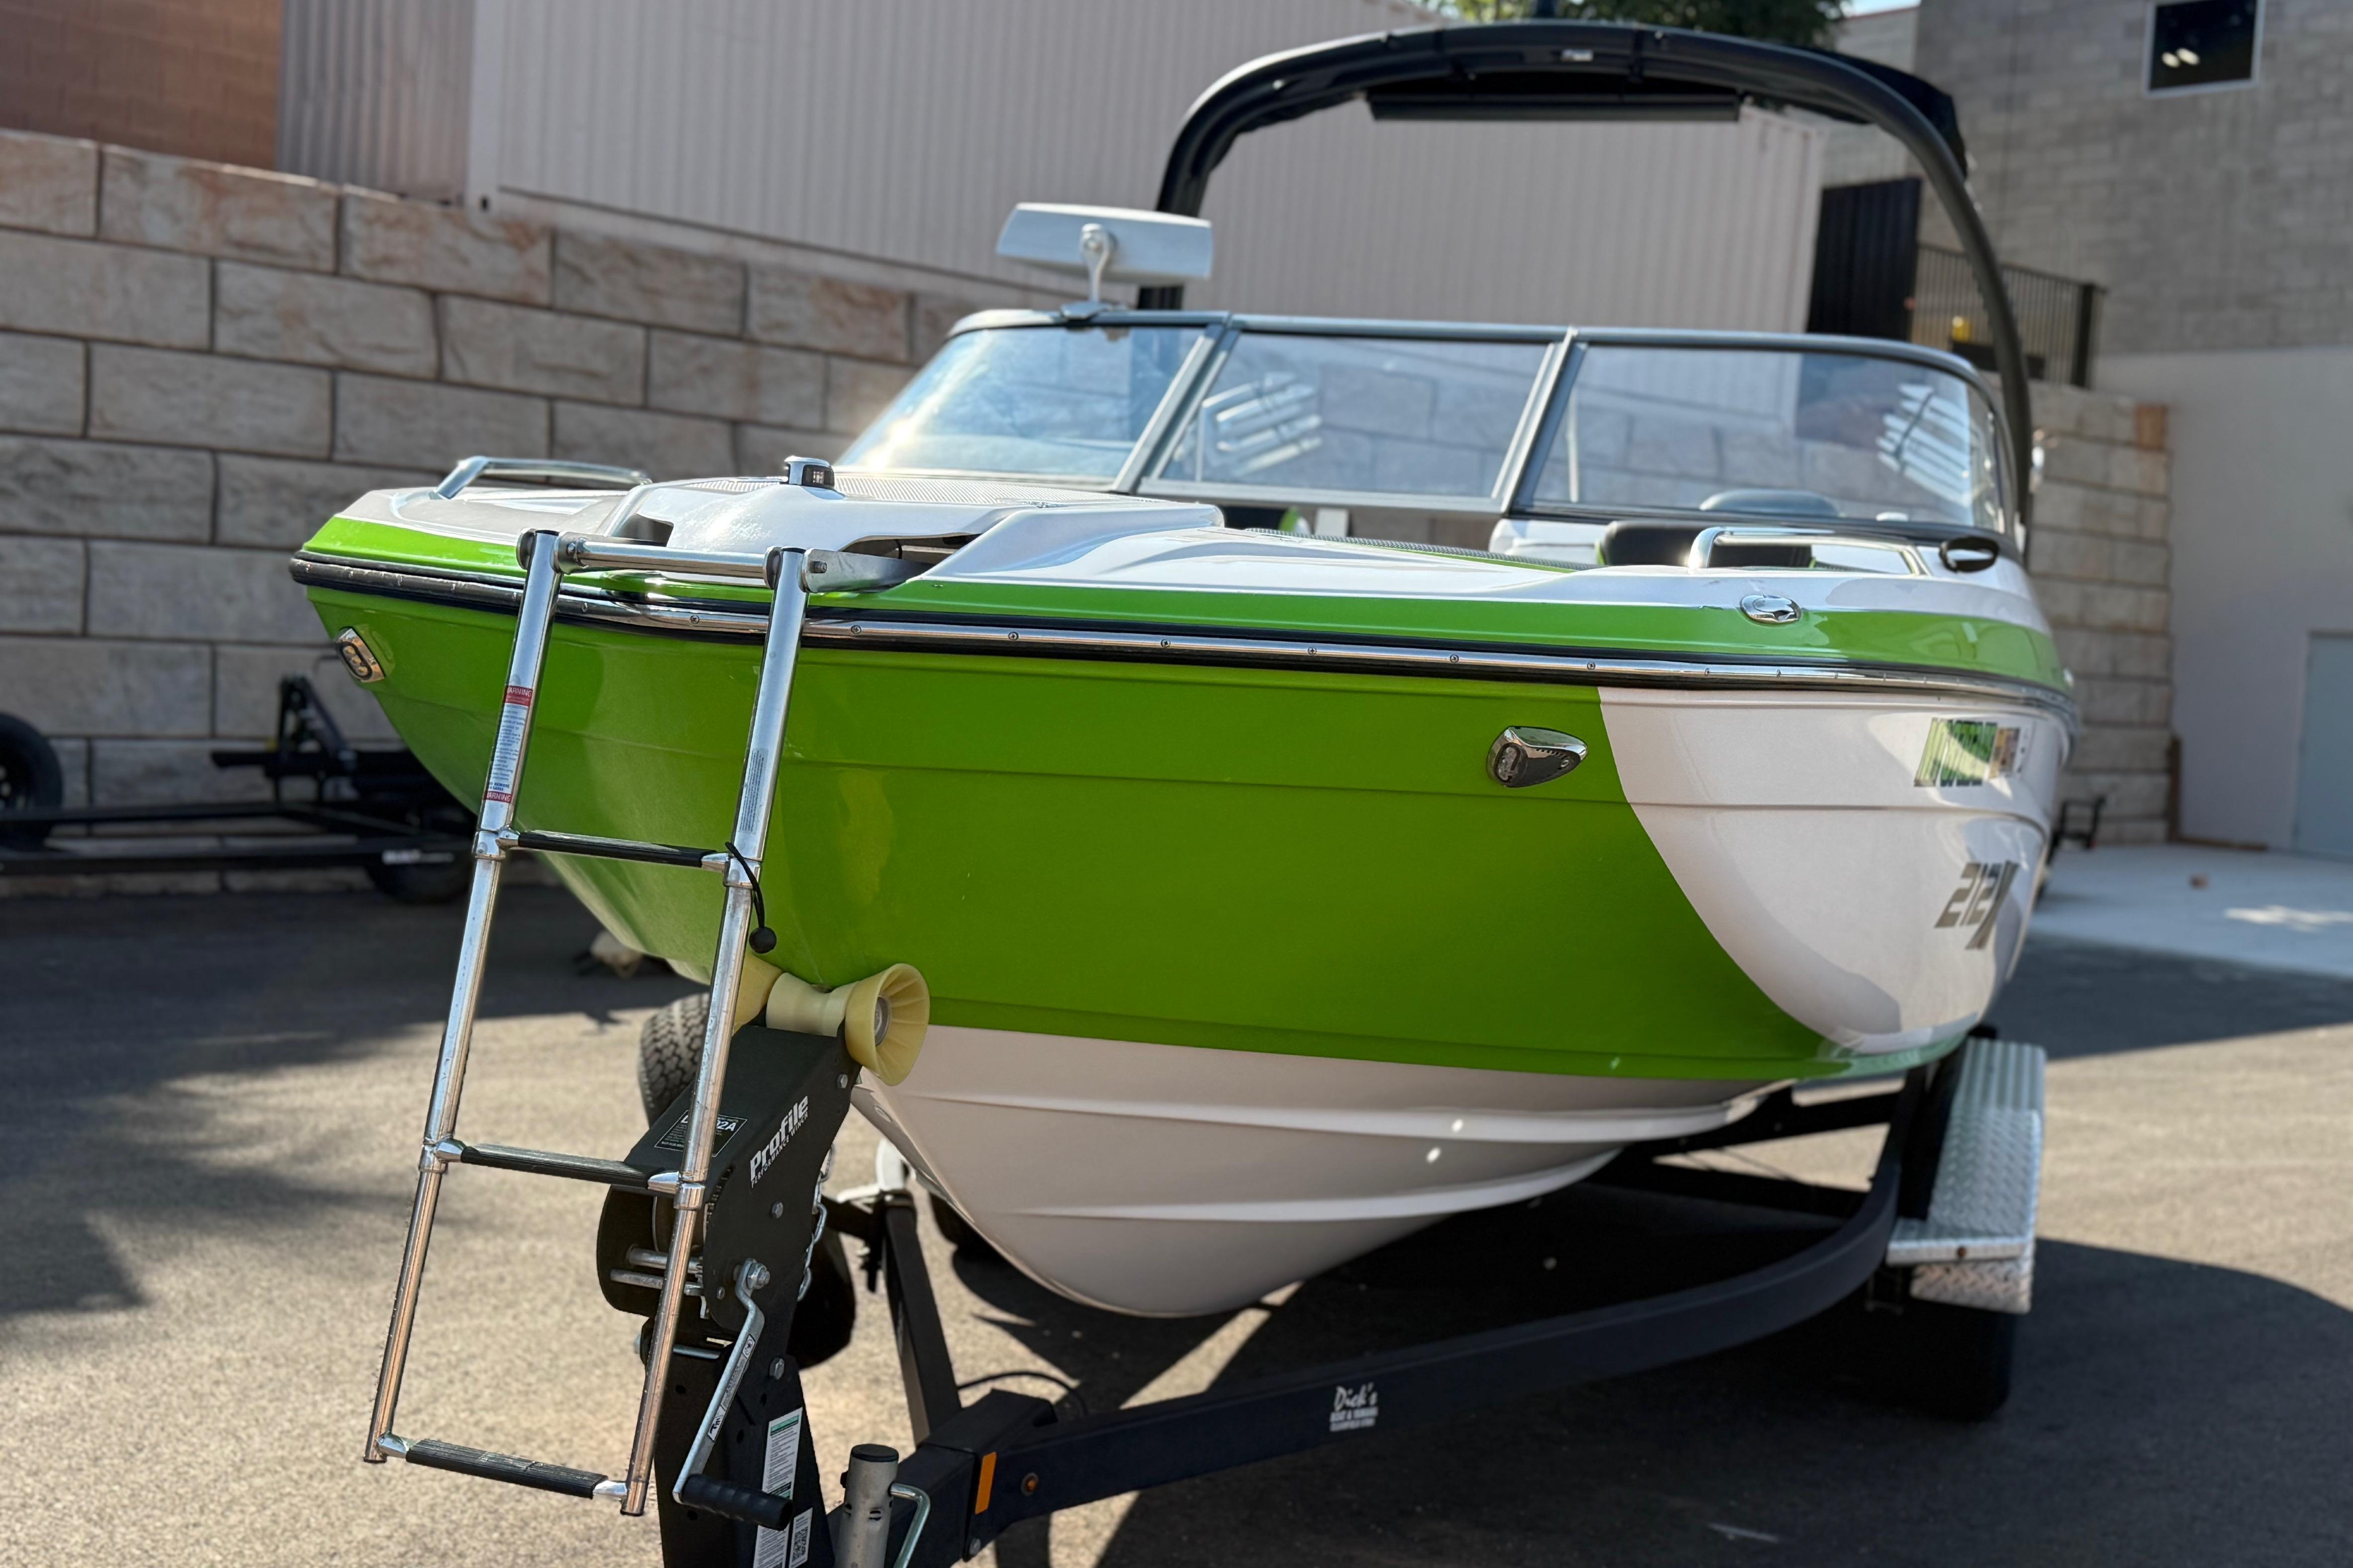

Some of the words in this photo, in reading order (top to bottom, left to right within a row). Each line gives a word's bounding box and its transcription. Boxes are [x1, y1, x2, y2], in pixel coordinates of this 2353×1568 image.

[508, 686, 532, 697] ARNING
[750, 1095, 808, 1181] Profile
[751, 1135, 790, 1188] PERFORMANCE
[791, 1111, 808, 1137] WINCH
[1334, 1382, 1378, 1412] Dick's
